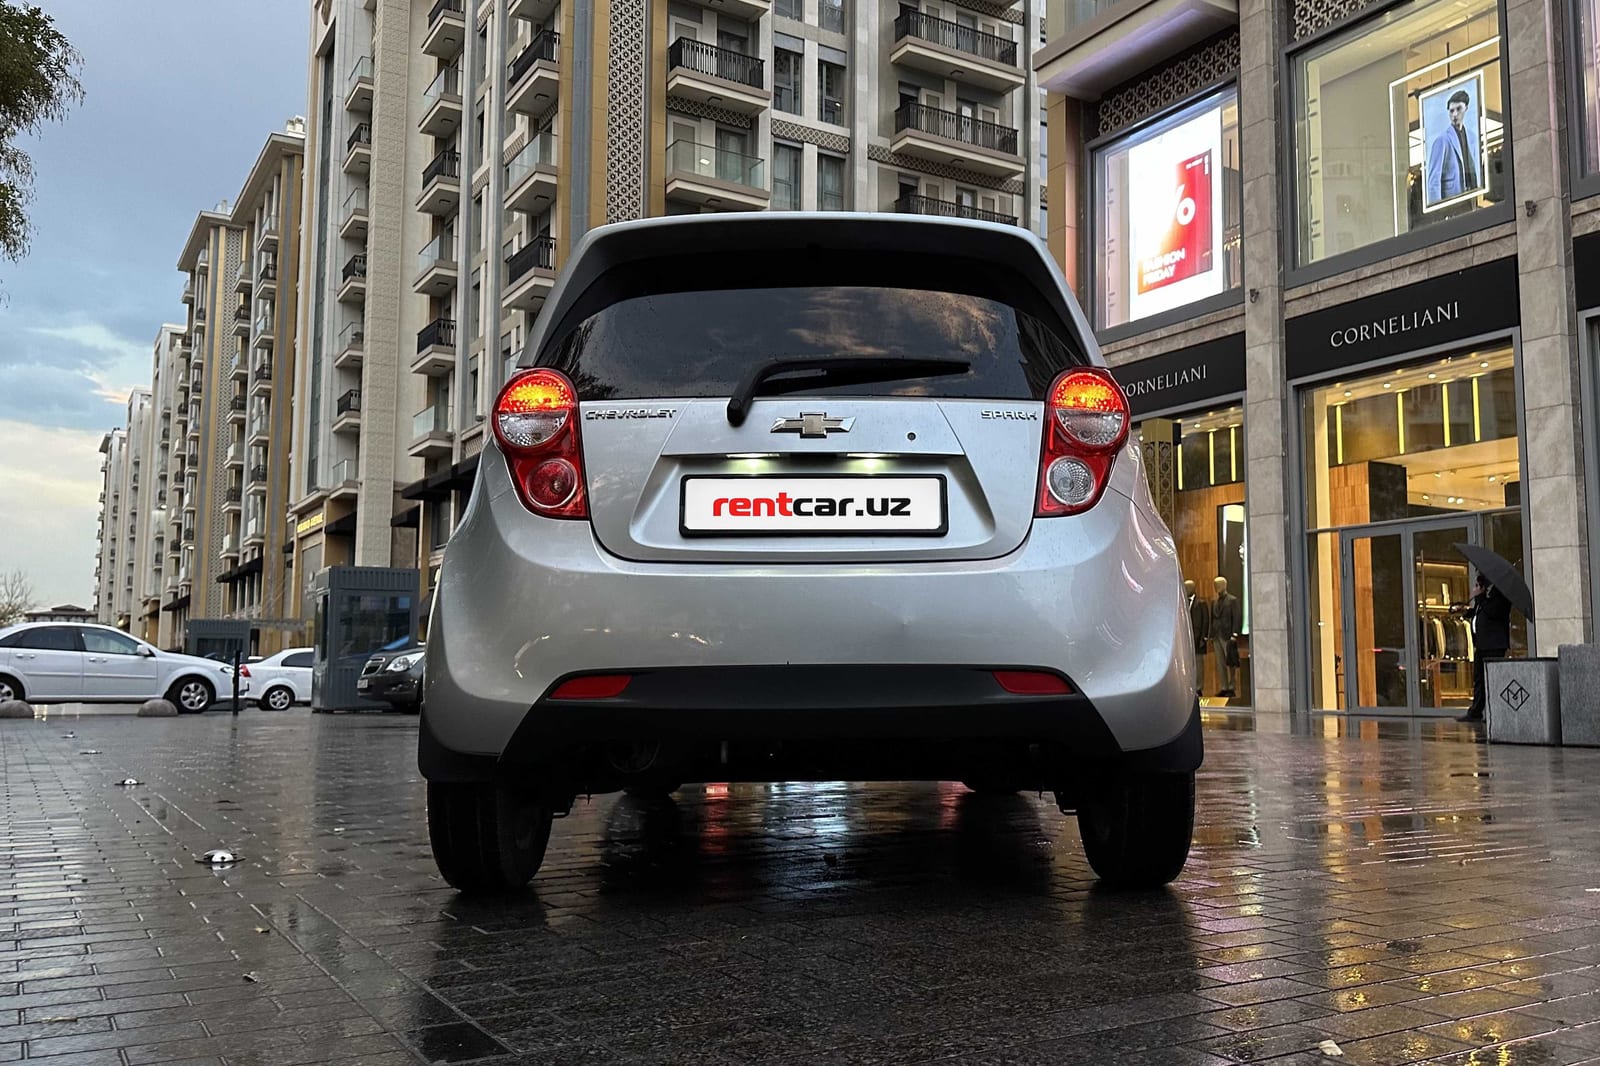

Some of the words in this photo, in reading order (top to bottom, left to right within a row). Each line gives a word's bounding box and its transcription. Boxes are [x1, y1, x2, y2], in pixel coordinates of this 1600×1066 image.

[1330, 301, 1459, 347] CORNELIANI
[1122, 364, 1207, 398] ORNELIANI
[585, 408, 677, 420] CHEVROLET
[981, 409, 1038, 421] SPARK
[713, 492, 911, 517] rentcar.uz
